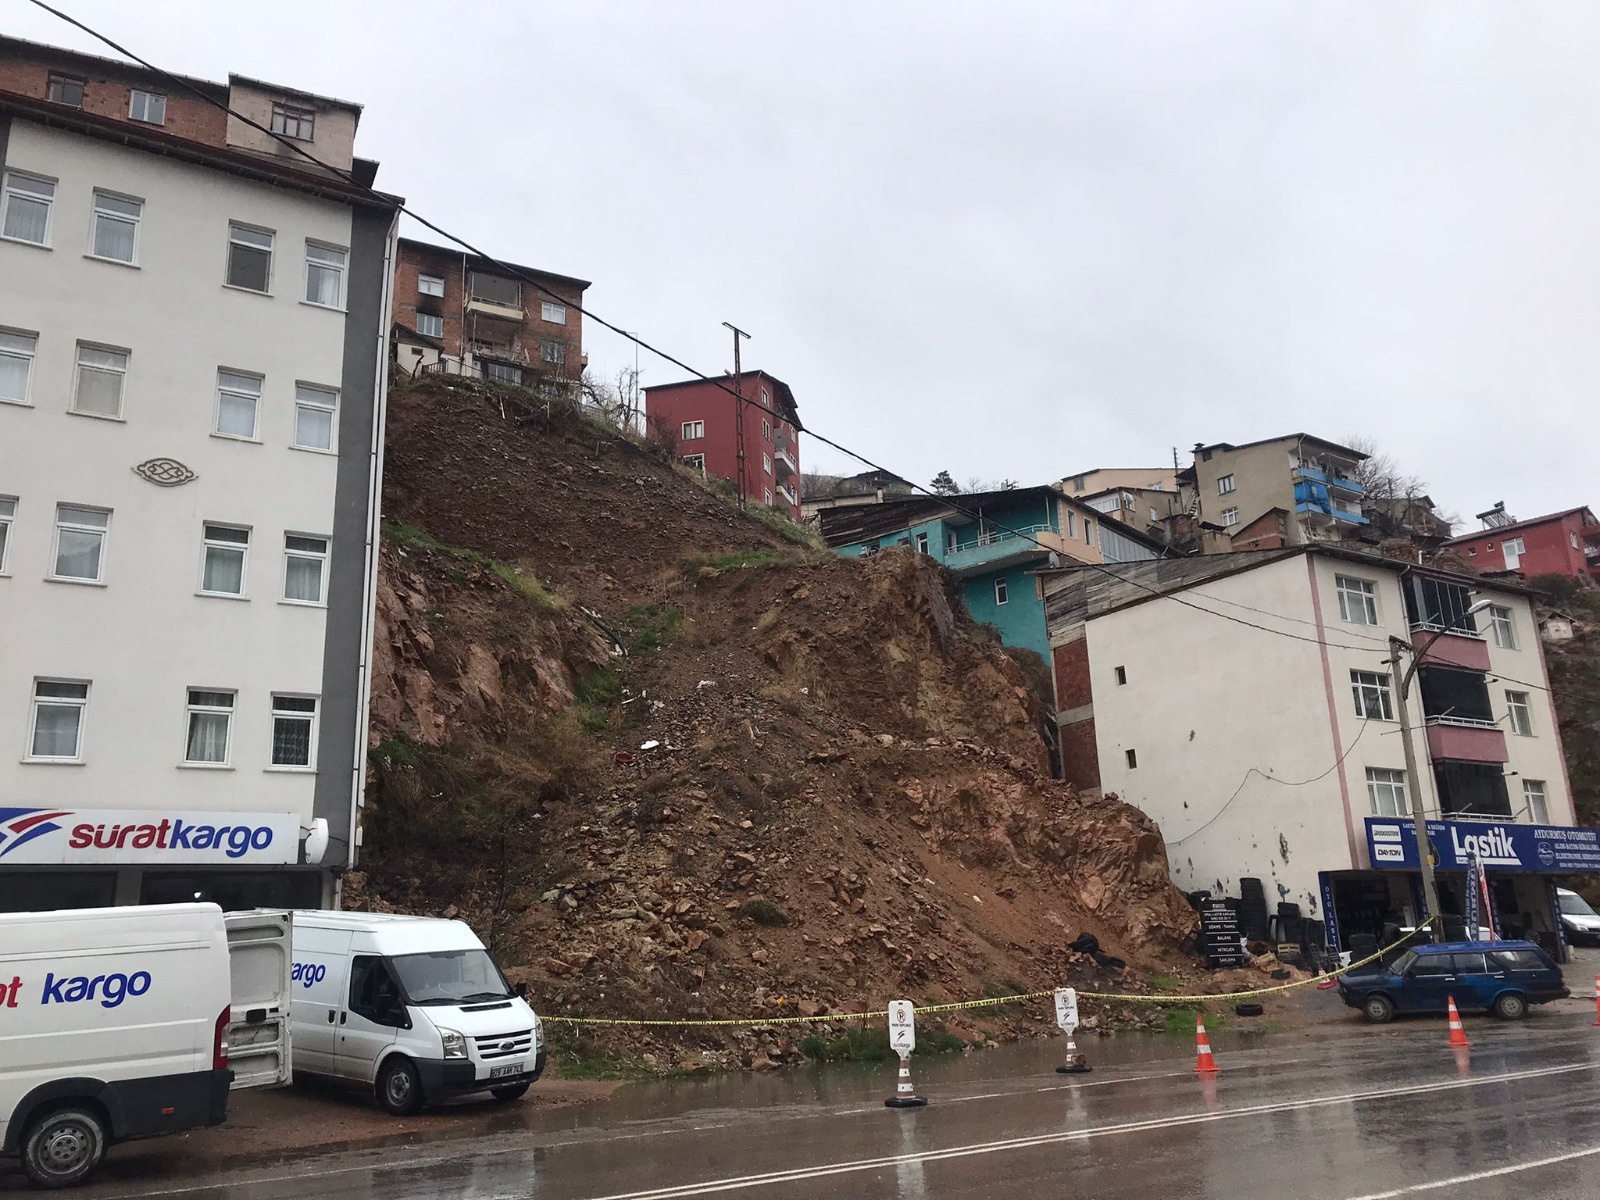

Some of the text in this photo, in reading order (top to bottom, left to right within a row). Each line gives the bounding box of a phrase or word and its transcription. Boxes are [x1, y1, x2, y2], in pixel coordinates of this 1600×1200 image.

[1451, 826, 1517, 857] Lastik
[41, 970, 152, 1008] kargo
[291, 962, 326, 988] argo
